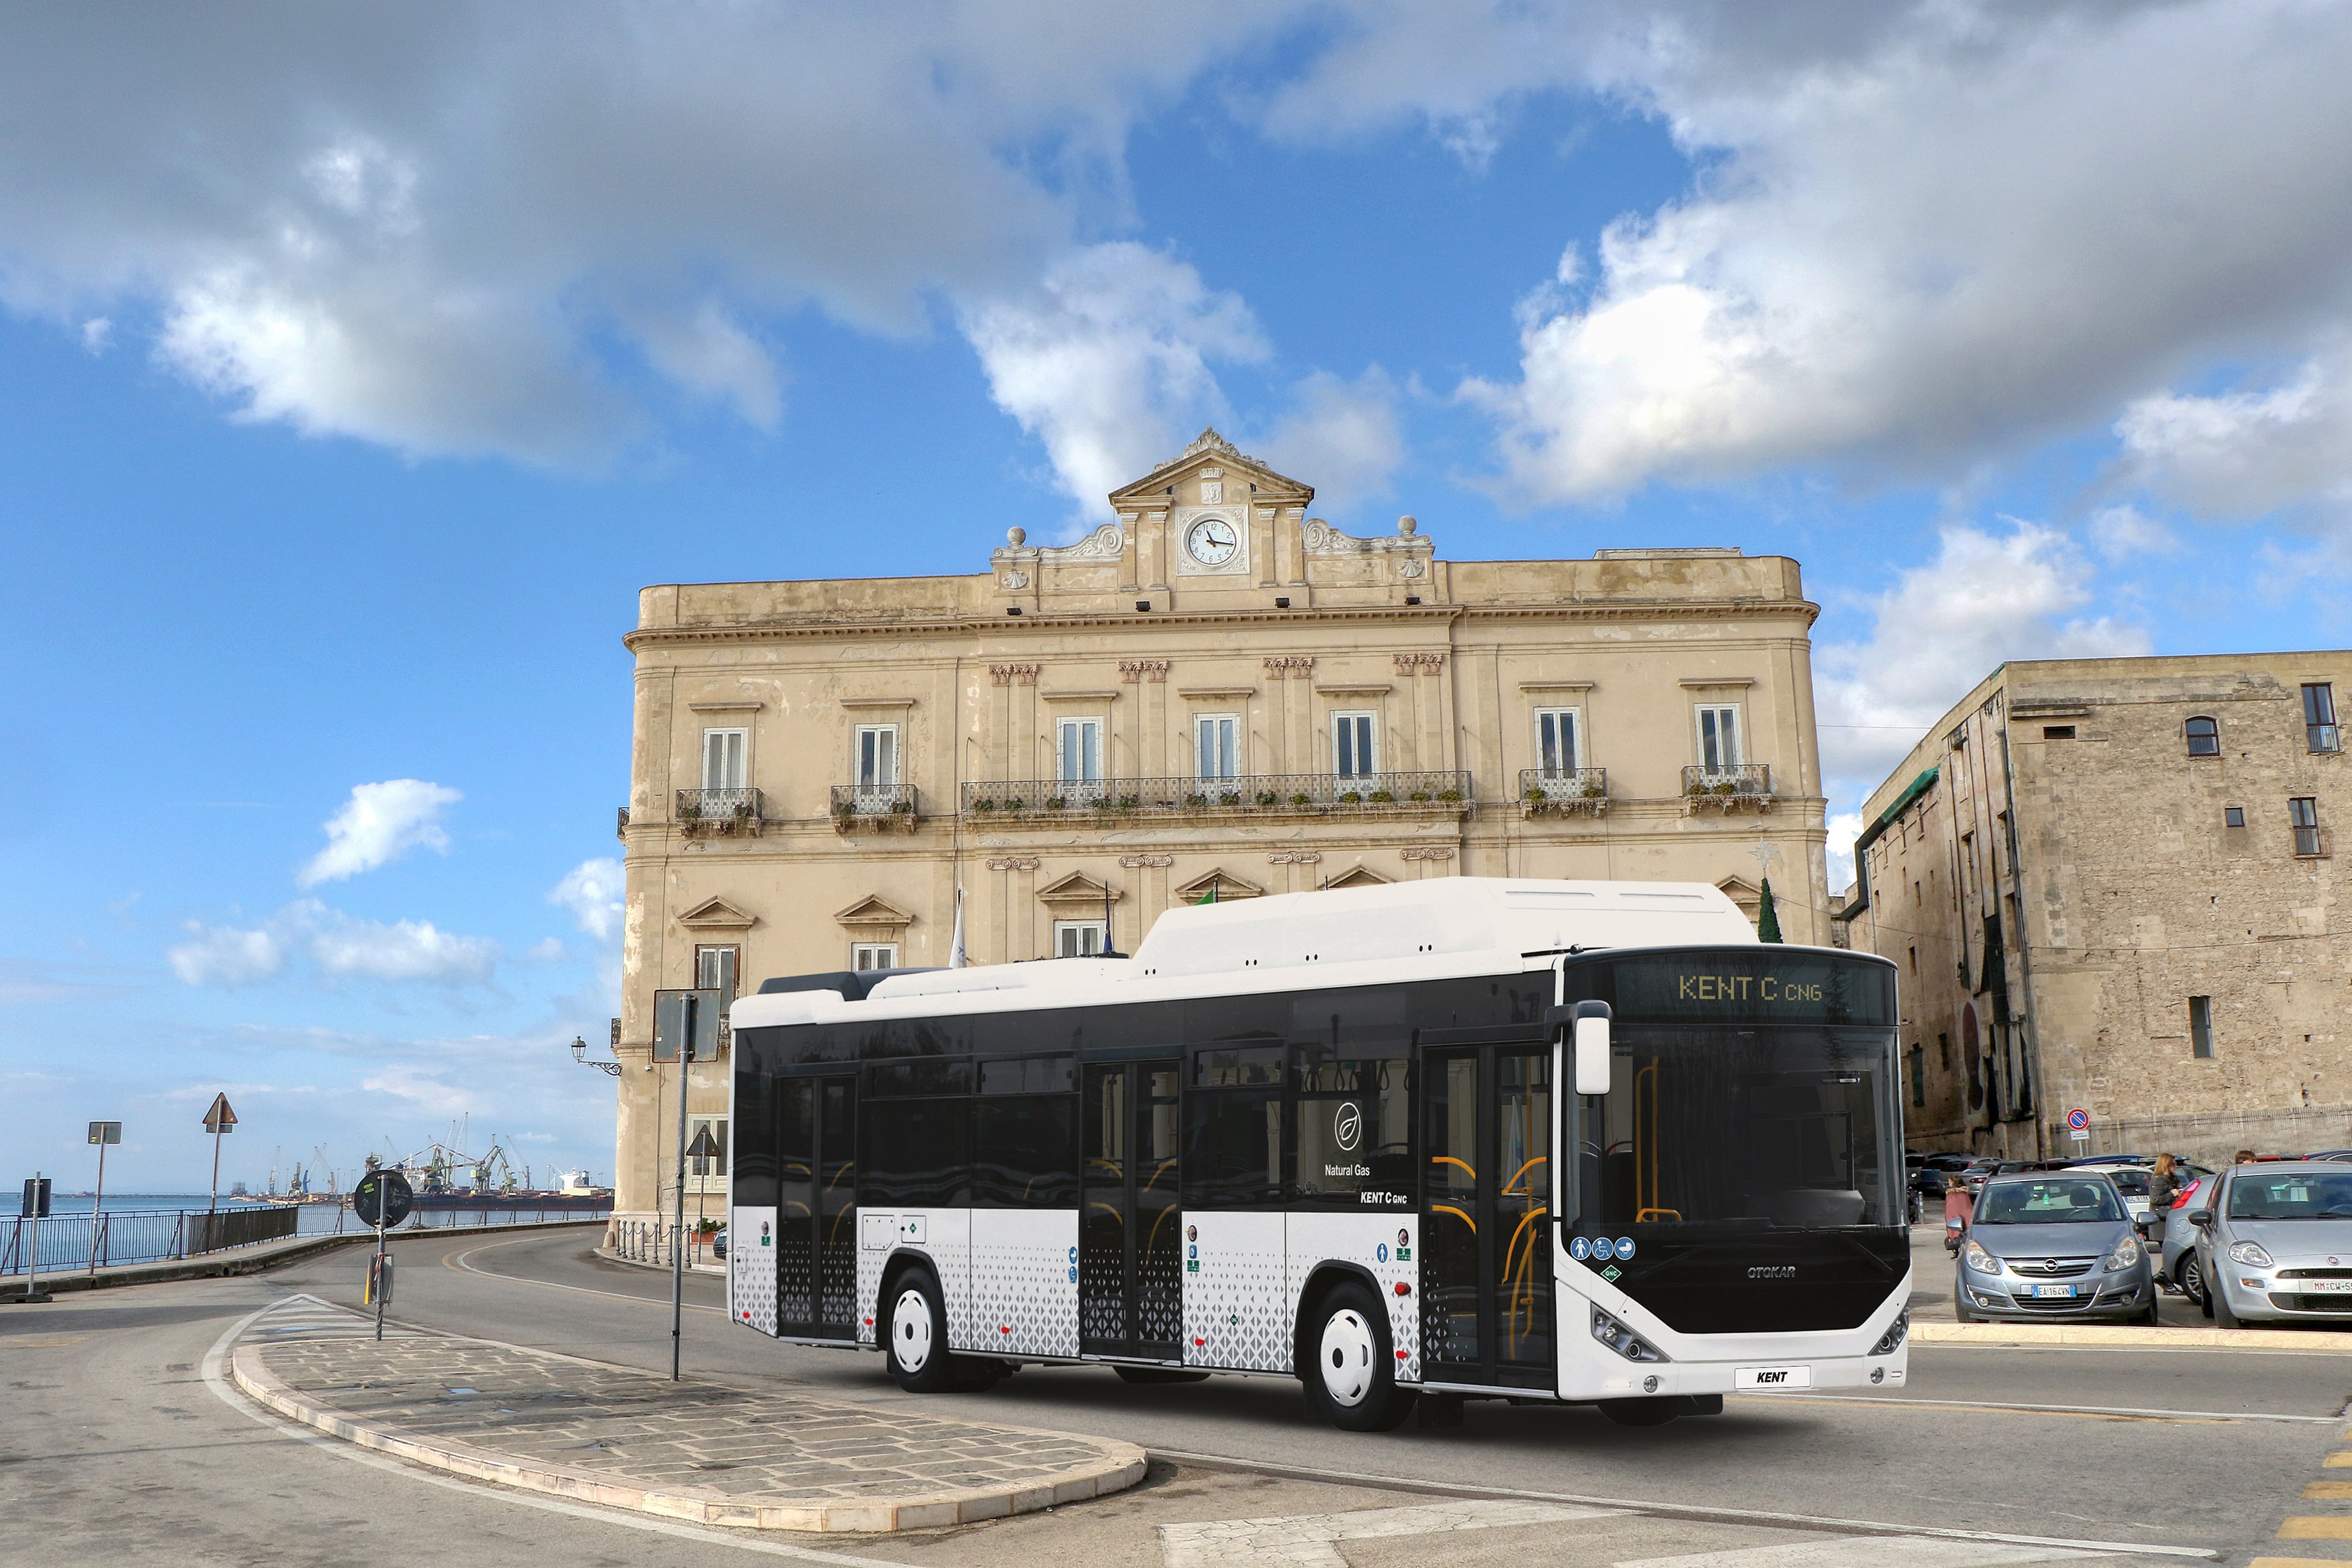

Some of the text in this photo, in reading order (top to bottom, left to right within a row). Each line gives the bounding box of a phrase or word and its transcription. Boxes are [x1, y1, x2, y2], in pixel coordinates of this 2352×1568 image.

[1680, 975, 1822, 1001] KENT C CNG
[1325, 1164, 1370, 1176] Natural Gas
[1360, 1192, 1407, 1204] KENT C GNC
[1747, 1266, 1796, 1278] OTOKAR
[1757, 1372, 1788, 1383] KENT
